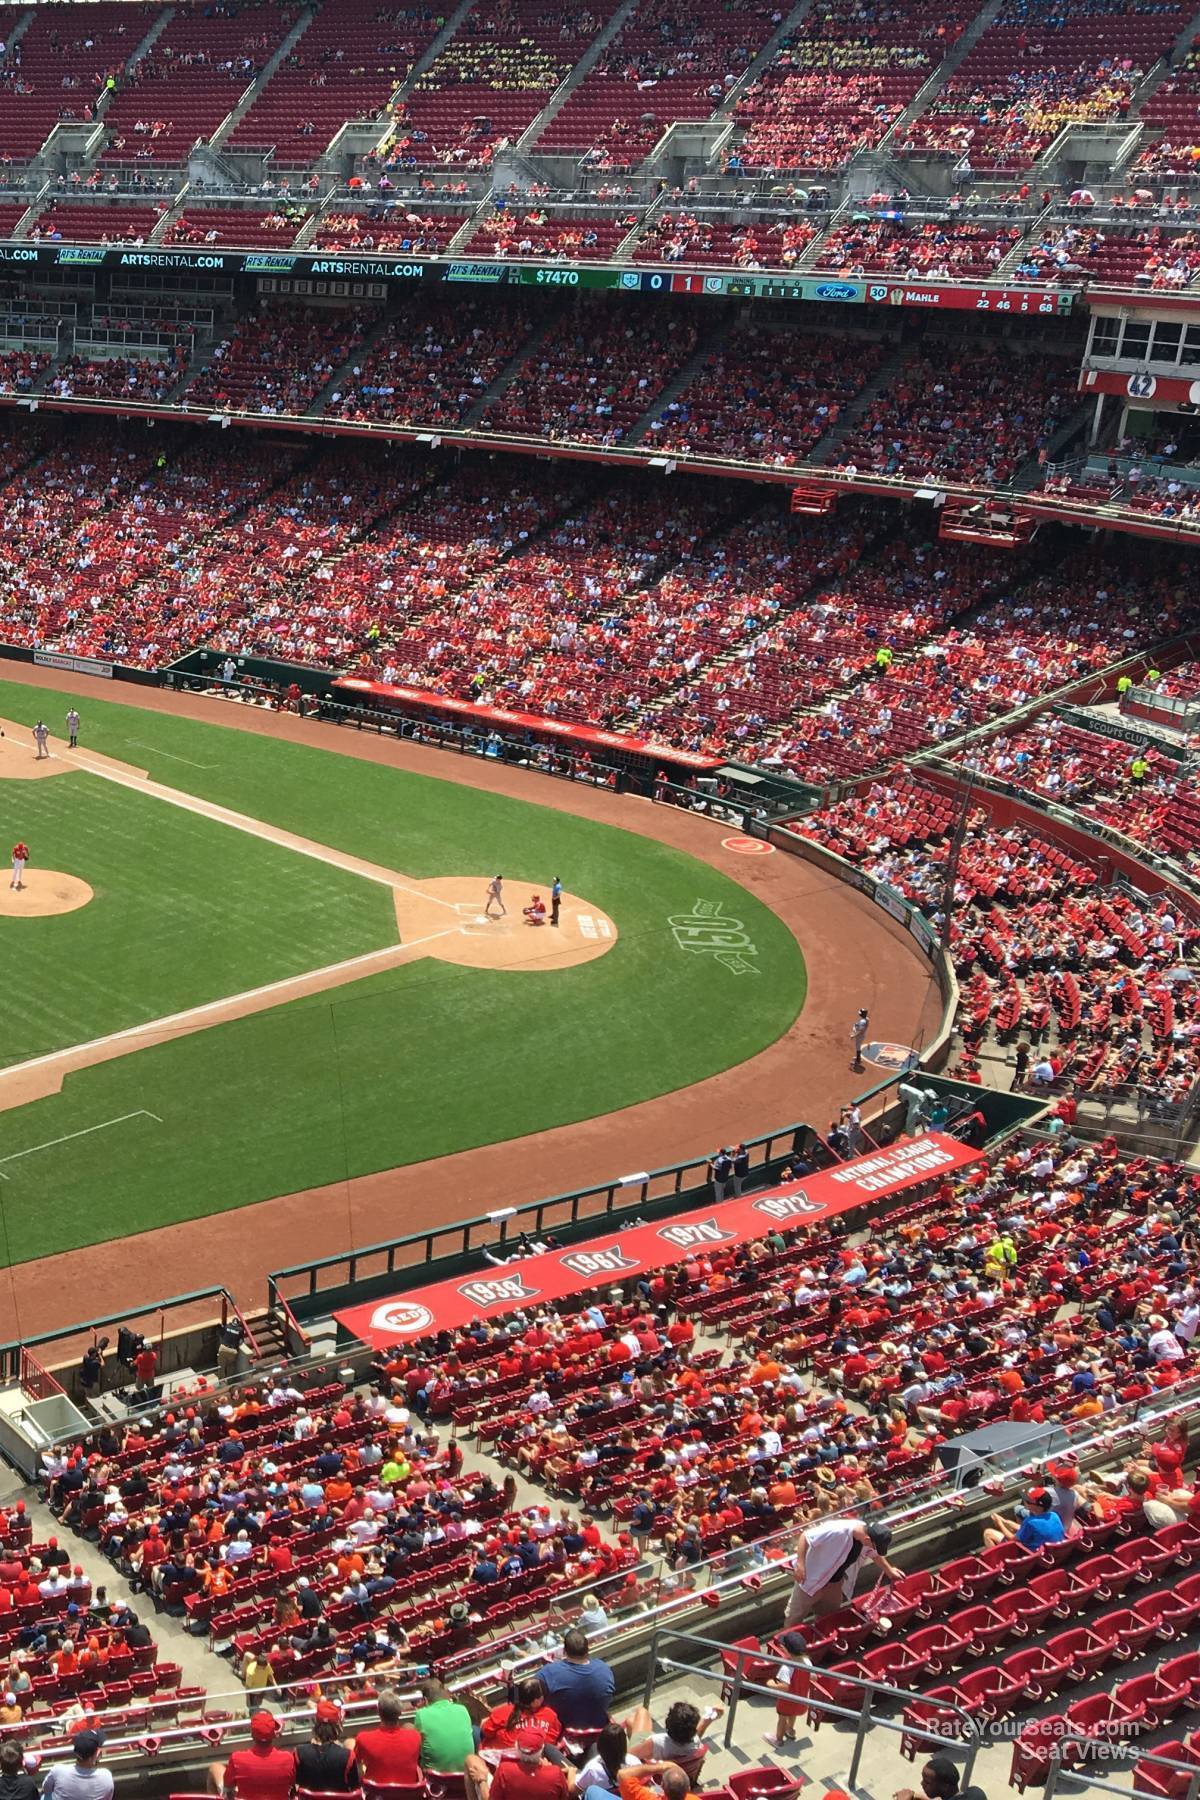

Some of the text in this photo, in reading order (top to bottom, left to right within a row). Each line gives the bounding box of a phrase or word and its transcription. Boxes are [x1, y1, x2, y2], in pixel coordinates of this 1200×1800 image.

[77, 249, 104, 260] RENTAL
[120, 253, 224, 268] ARTSRENTAL.COM
[265, 256, 295, 267] RENTAL
[312, 261, 423, 277] ARTSRENTAL.COM
[470, 265, 502, 277] RENTAL
[536, 269, 579, 284] $7470
[650, 277, 662, 289] 0
[684, 276, 692, 290] 1
[744, 286, 751, 294] 5
[768, 287, 799, 297] 1 1 2
[822, 287, 849, 298] Ford
[871, 288, 885, 298] 30
[976, 299, 1053, 313] 22 46 5 68
[1129, 376, 1153, 397] 42
[1088, 720, 1148, 744] SCOUTS CLUB
[830, 1138, 941, 1183] NATIONAL LEAGUE
[855, 1149, 955, 1192] CHAMPIONS
[759, 1194, 818, 1219] 1972
[663, 1222, 723, 1247] 1970
[567, 1250, 627, 1274] 1961
[464, 1280, 526, 1304] 1939
[387, 1305, 429, 1325] REDS
